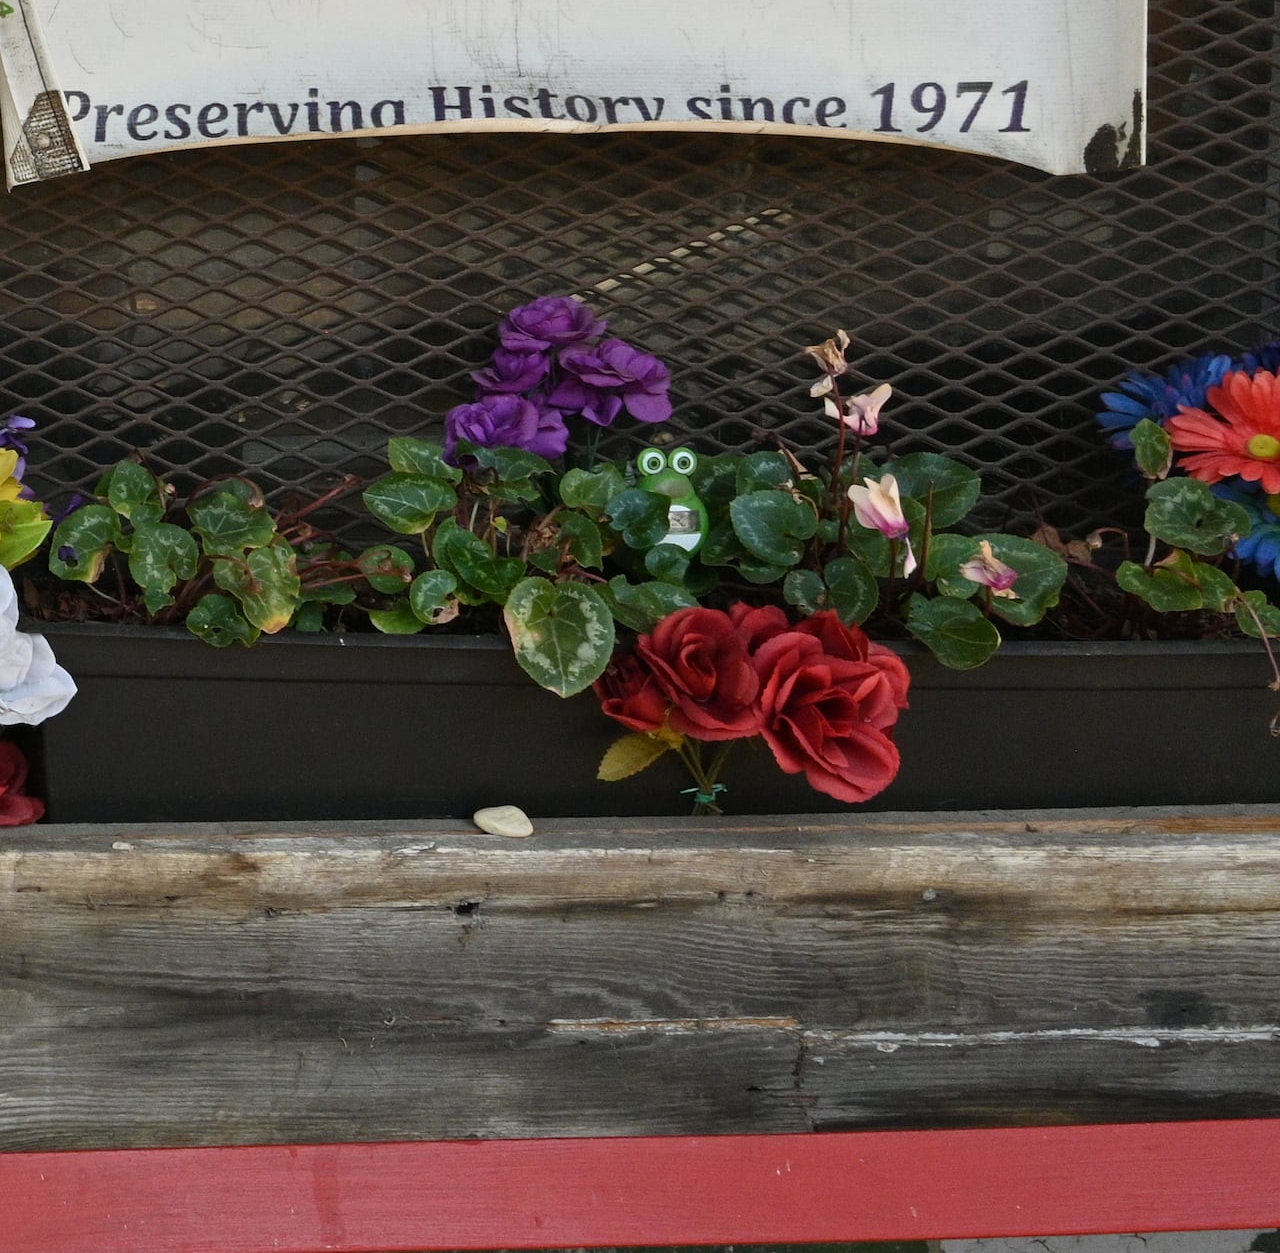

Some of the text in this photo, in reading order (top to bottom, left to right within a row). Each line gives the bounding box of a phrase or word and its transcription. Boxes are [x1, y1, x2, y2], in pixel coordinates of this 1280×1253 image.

[64, 80, 1032, 143] Preserving History since 1971
